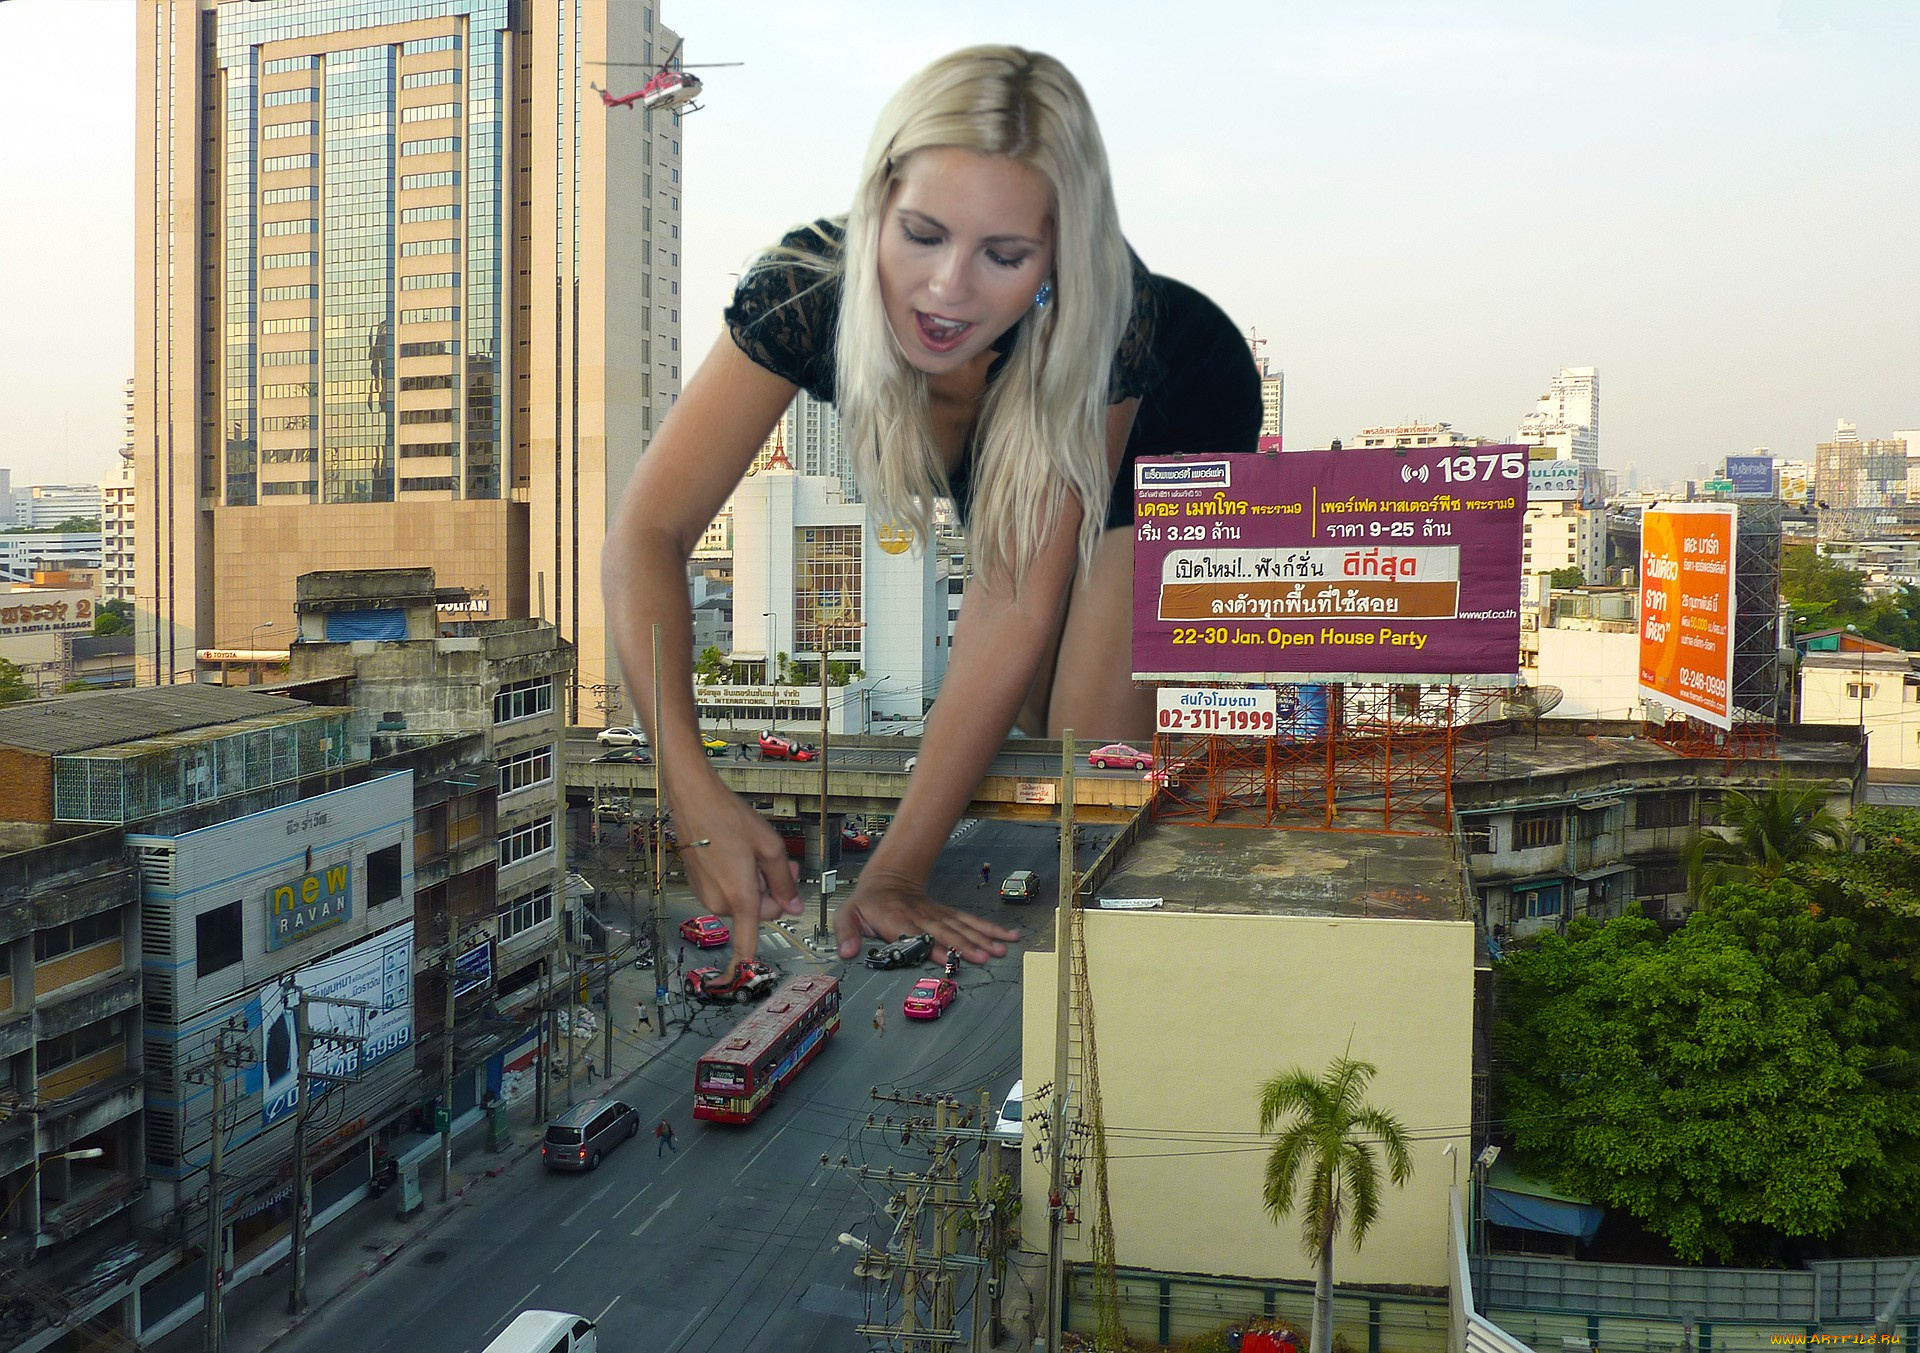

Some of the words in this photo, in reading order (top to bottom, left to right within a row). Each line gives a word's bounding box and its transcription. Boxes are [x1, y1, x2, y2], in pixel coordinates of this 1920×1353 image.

[1436, 452, 1525, 483] 1375
[1528, 469, 1578, 477] ULIAN
[1137, 502, 1180, 517] เดอะ
[1185, 491, 1249, 517] เมทโทร
[1250, 503, 1302, 515] พระราม9
[1466, 497, 1515, 510] พระราม9
[1137, 520, 1161, 541] เริ่ม
[1167, 525, 1206, 541] 3.29
[1211, 521, 1241, 541] ล้าน
[1326, 522, 1364, 539] ราคา
[1369, 521, 1415, 538] 9-25
[1422, 518, 1452, 537] ล้าน
[1343, 547, 1417, 582] ดีที่สุด
[76, 598, 92, 619] 2
[1211, 583, 1399, 618] ลงตัวทุกพื้นที่ใช้สอย
[1645, 589, 1668, 612] ราคา
[53, 620, 92, 631] MASSAGE
[1172, 626, 1229, 645] 22-30
[1231, 628, 1265, 645] Jan.
[1267, 627, 1315, 650] Open
[1320, 627, 1375, 646] House
[1379, 627, 1428, 650] Party
[1679, 666, 1726, 698] 02-246-0999
[1180, 691, 1257, 707] สนใจโฆษณา
[1159, 708, 1274, 731] 02-311-1999
[273, 864, 347, 917] new
[280, 895, 345, 933] RAVAN
